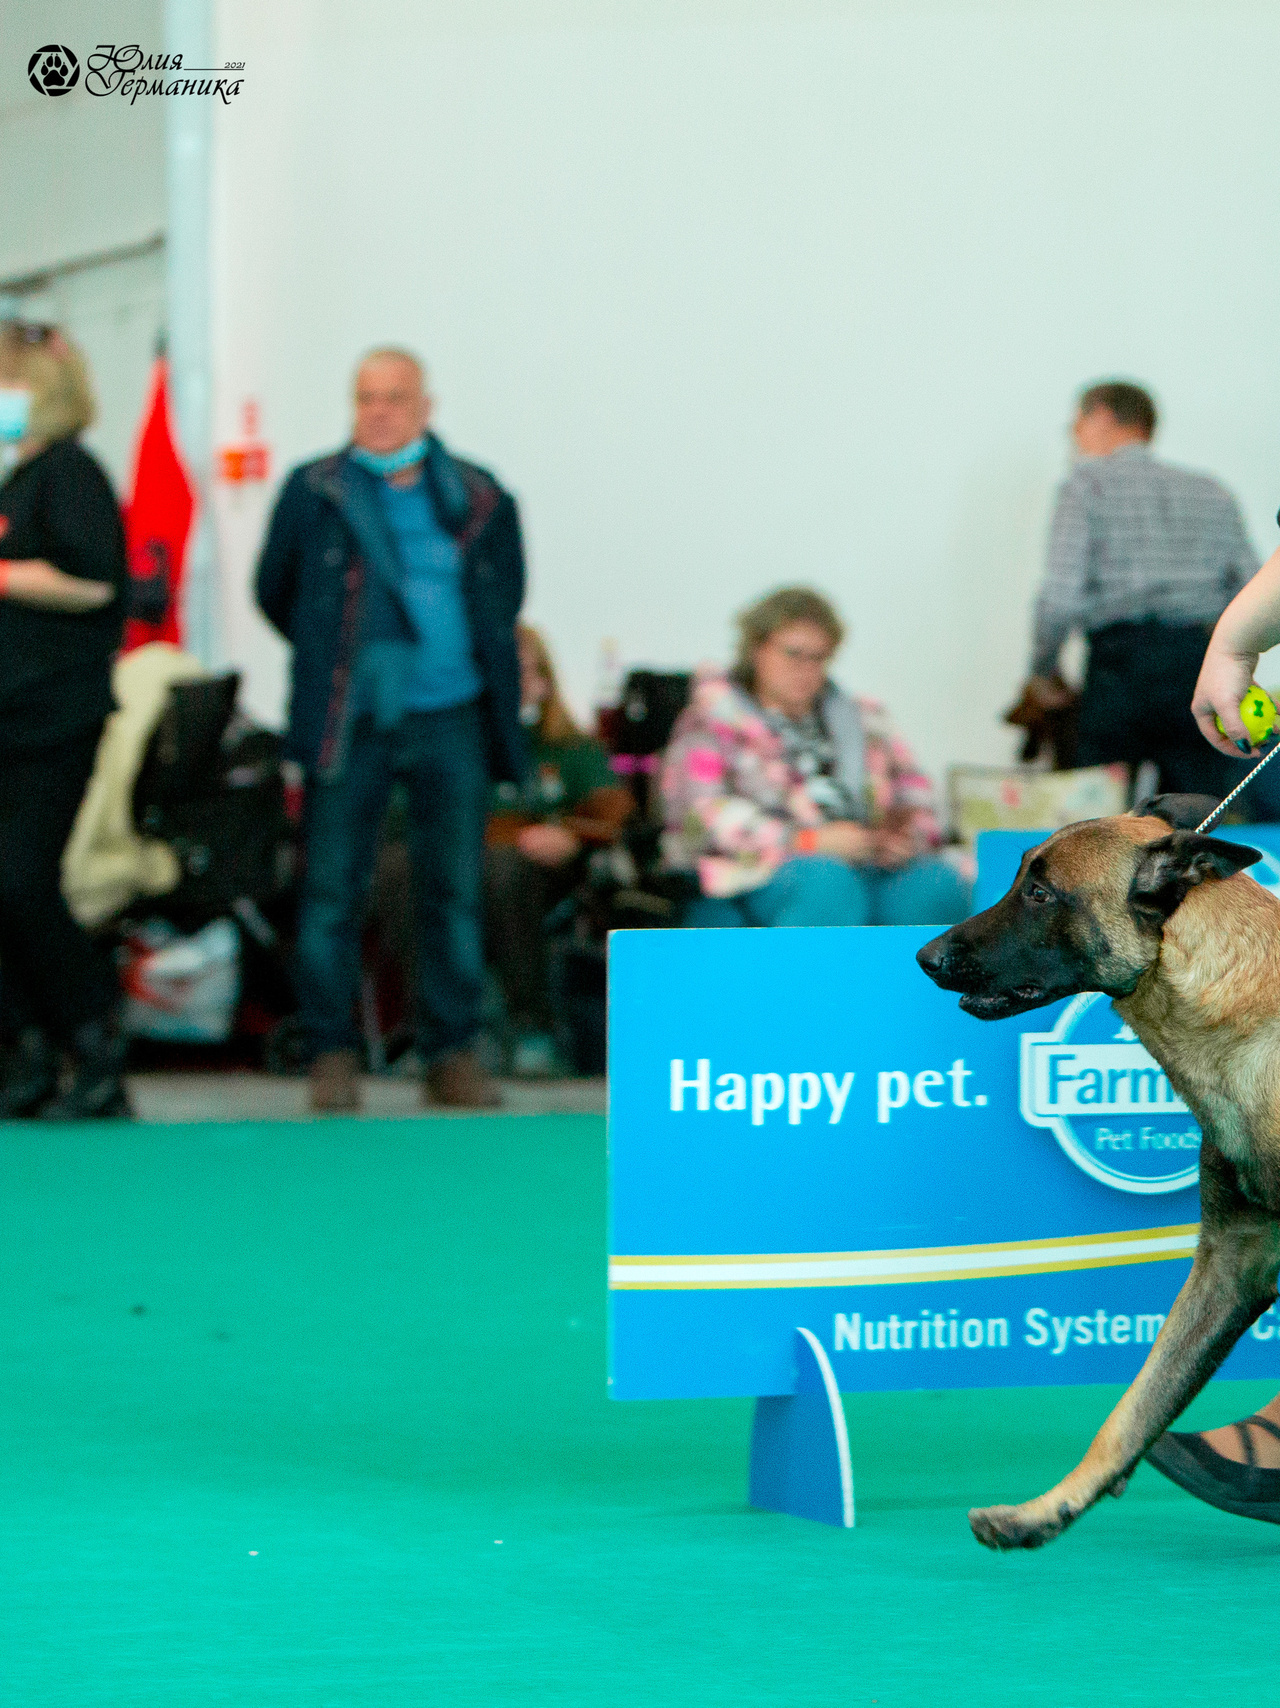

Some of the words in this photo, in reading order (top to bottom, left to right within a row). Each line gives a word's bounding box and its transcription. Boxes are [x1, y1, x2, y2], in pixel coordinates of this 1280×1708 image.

[670, 1058, 854, 1126] Happy
[877, 1058, 989, 1124] pet.
[1048, 1053, 1175, 1105] Farm
[1095, 1127, 1132, 1150] Pet
[833, 1308, 1009, 1351] Nutrition
[1024, 1307, 1166, 1355] System
